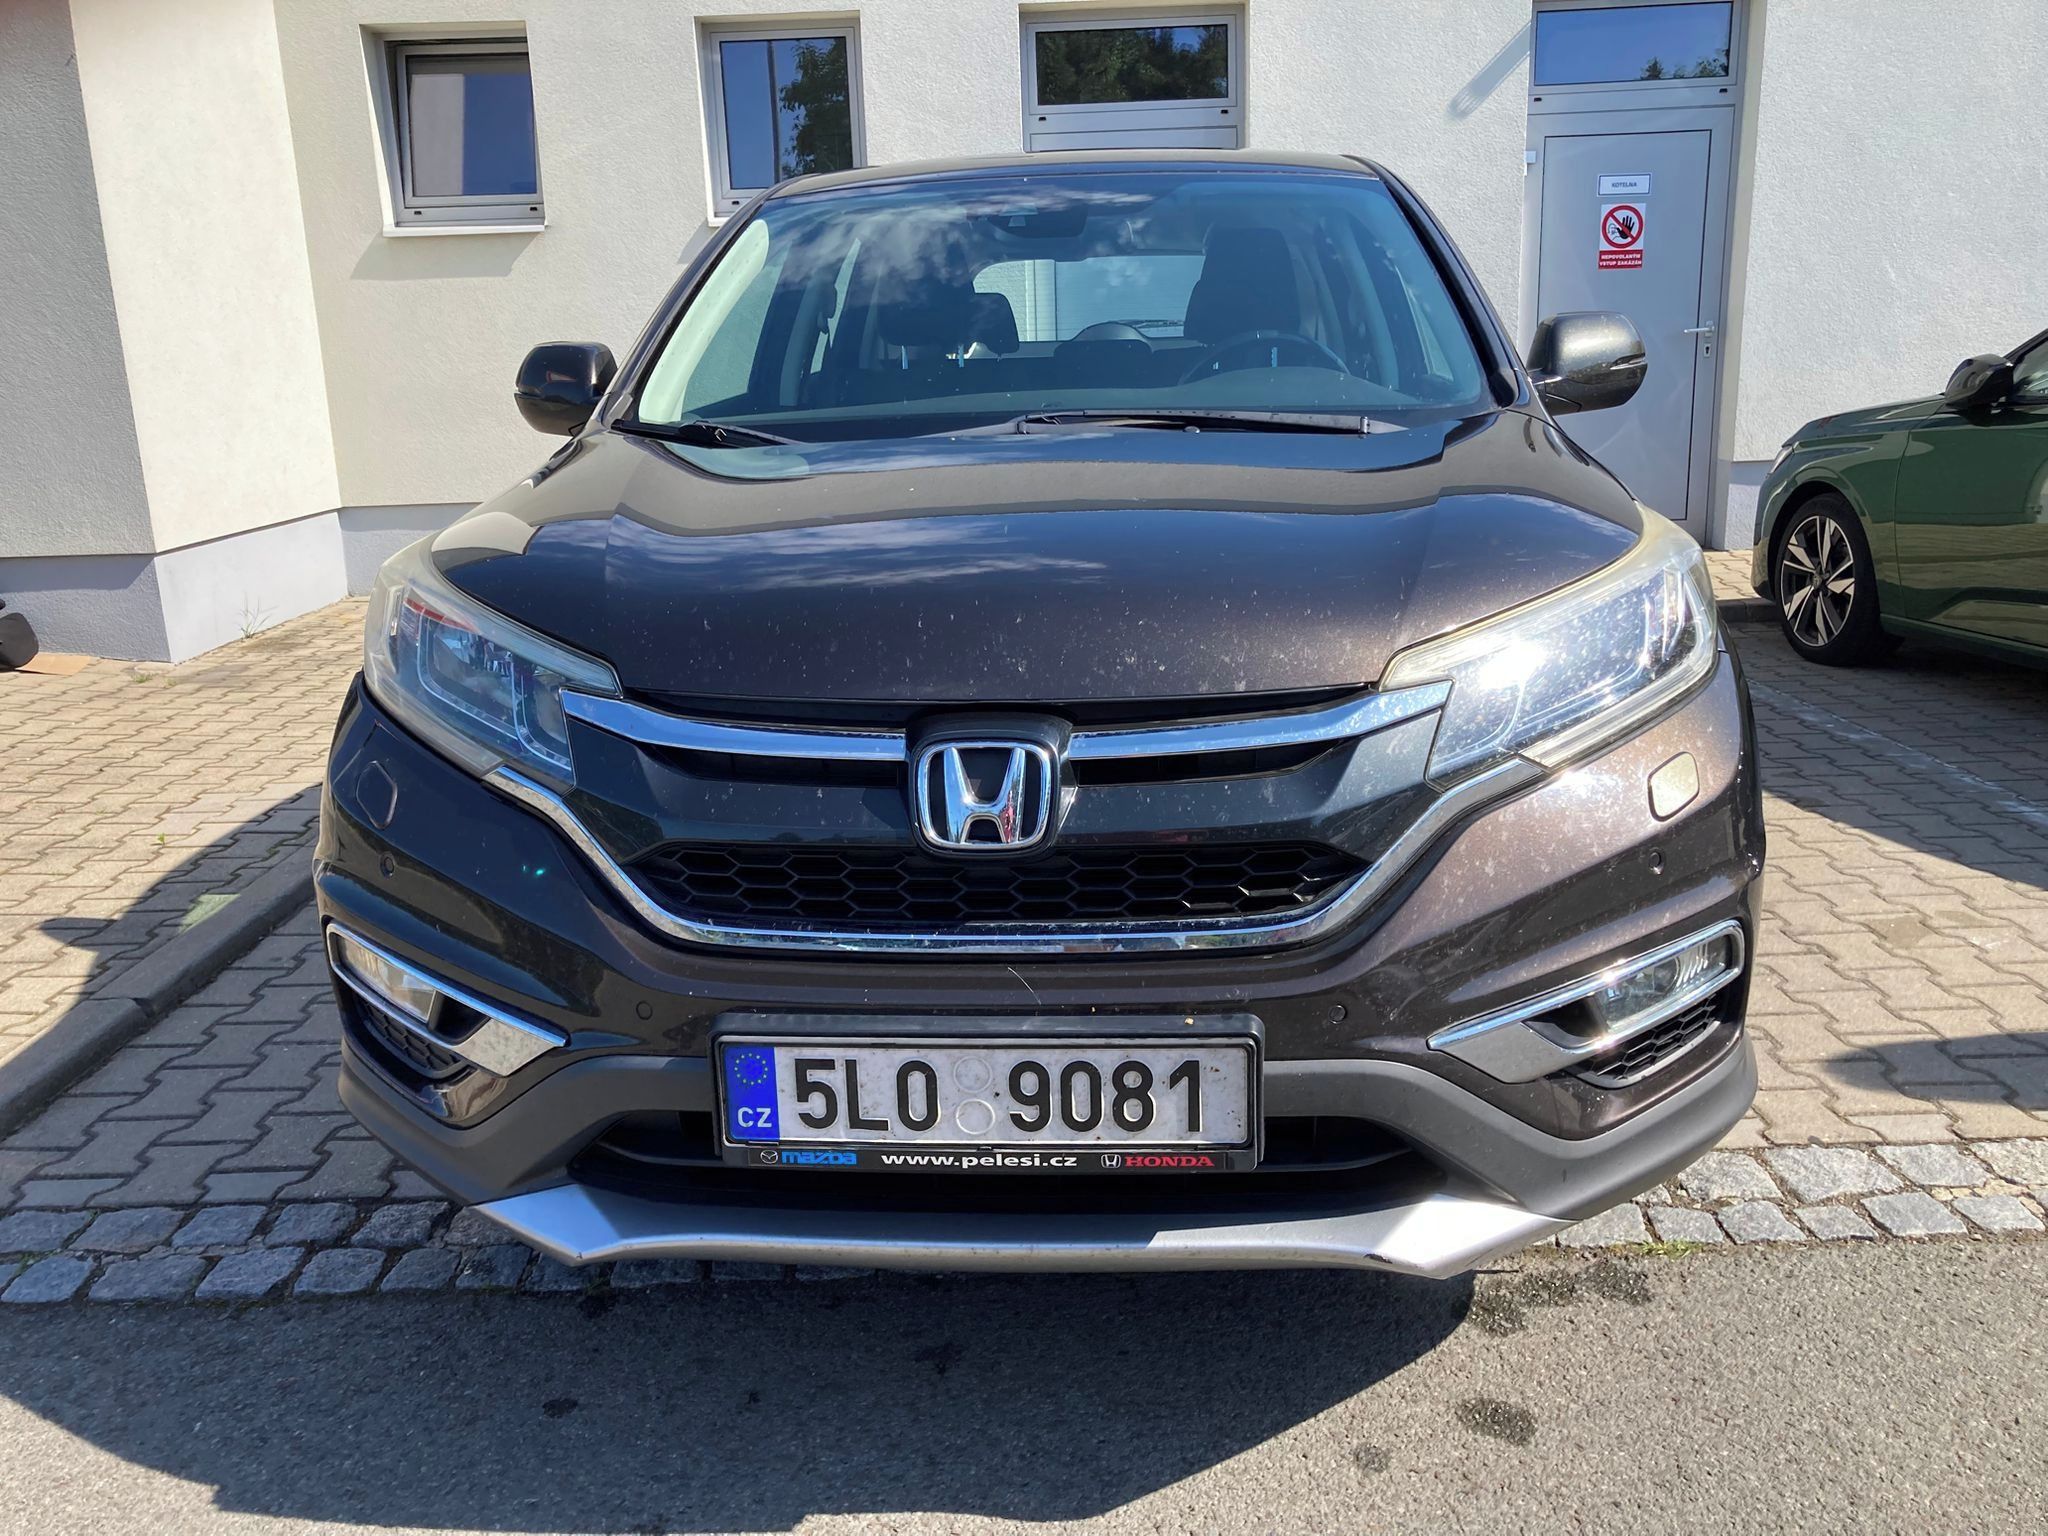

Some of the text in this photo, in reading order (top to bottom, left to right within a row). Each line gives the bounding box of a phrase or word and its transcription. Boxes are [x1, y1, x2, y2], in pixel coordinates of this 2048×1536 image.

[1008, 1059, 1203, 1133] 9081
[737, 1106, 772, 1129] CZ
[881, 1152, 1077, 1168] www.pelesi.cz
[1124, 1154, 1215, 1168] HONDA
